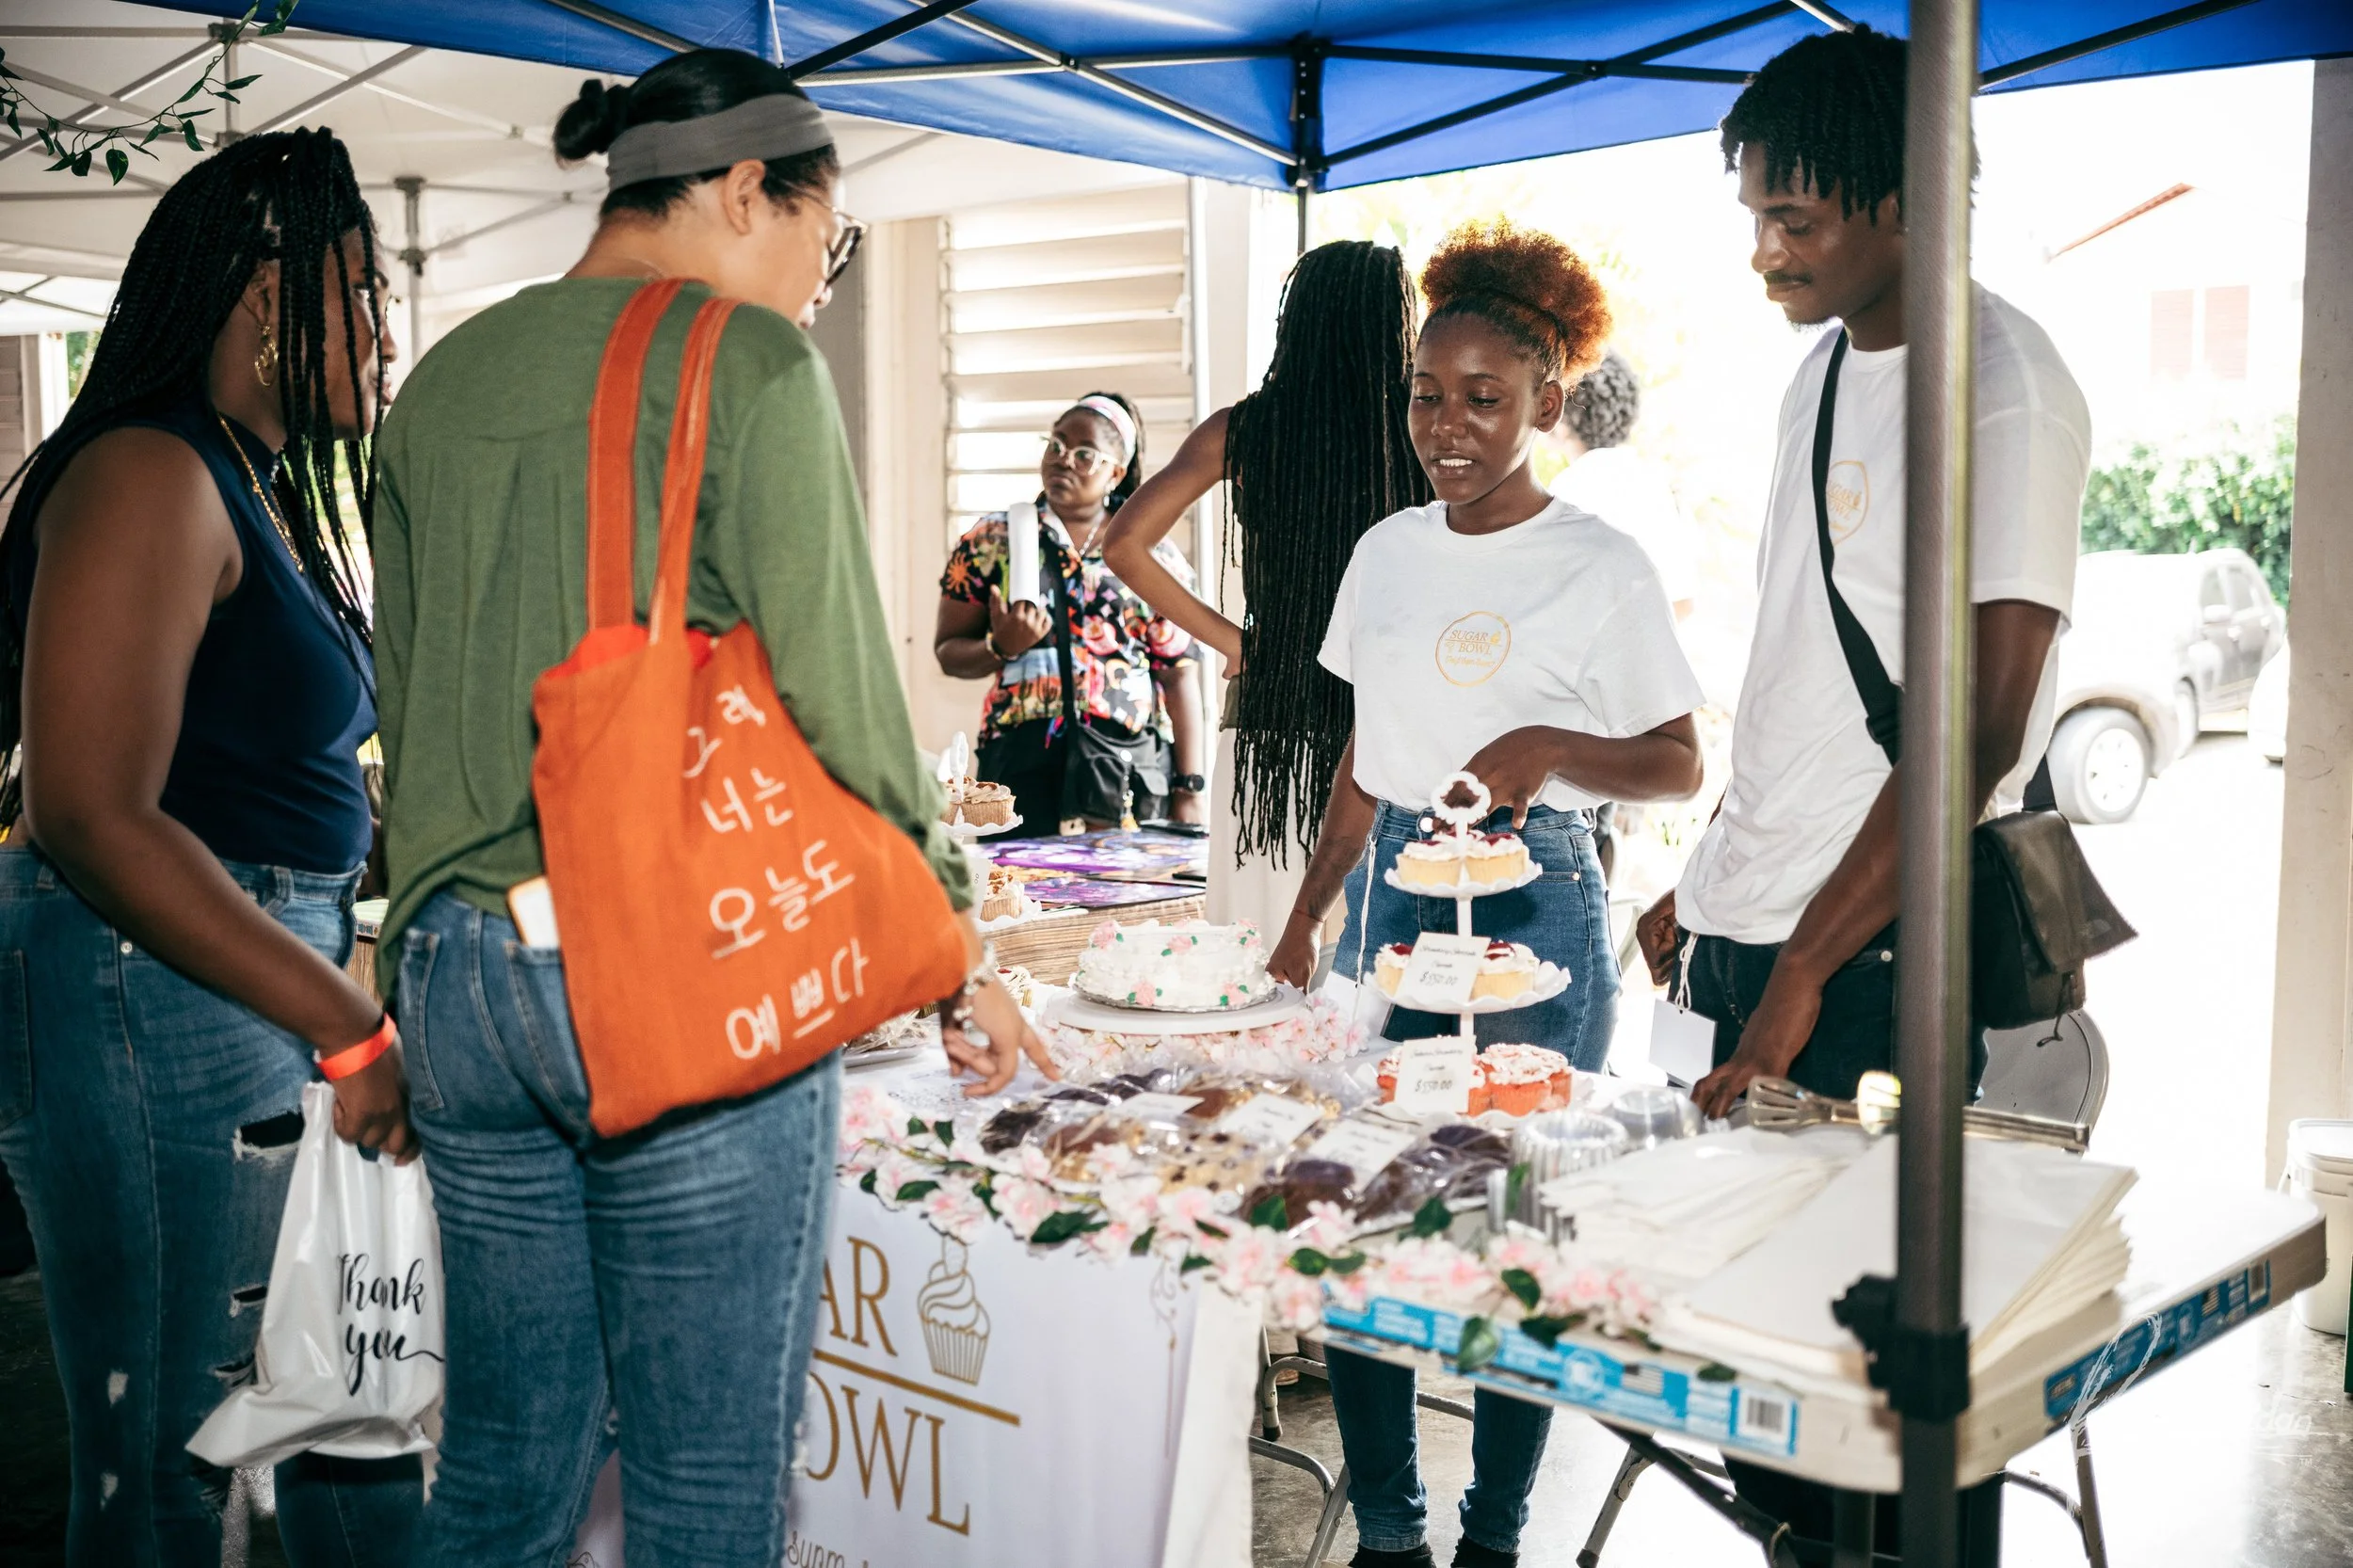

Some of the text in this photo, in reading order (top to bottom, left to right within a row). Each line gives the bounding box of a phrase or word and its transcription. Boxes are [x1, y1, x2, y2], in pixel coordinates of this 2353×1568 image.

[1450, 630, 1489, 641] SUGAR
[700, 766, 793, 833] 너는
[708, 839, 856, 959] 오늘도
[725, 936, 871, 1060] 예쁘다
[336, 1253, 425, 1315] Thank
[345, 1322, 445, 1397] you
